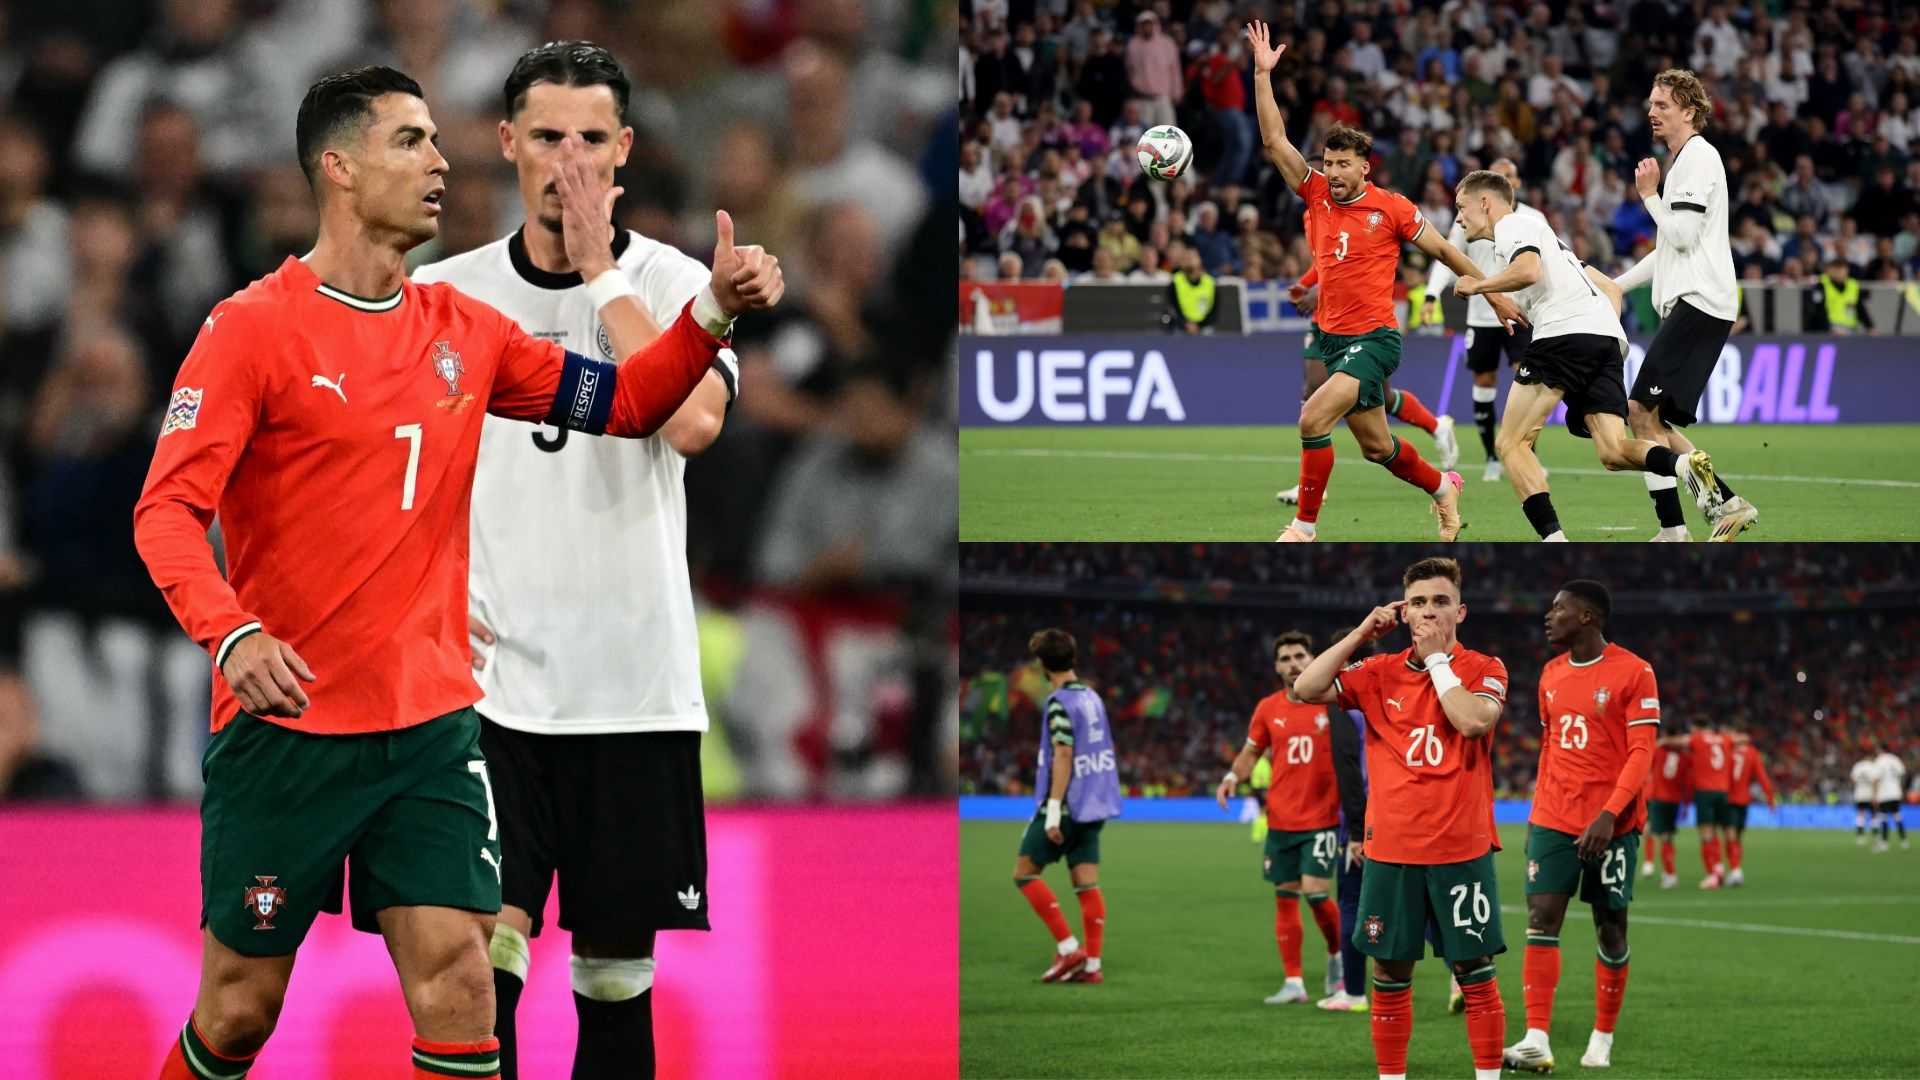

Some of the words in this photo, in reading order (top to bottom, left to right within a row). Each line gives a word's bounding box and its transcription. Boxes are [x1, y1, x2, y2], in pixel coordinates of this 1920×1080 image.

[1335, 231, 1350, 262] 3
[574, 368, 596, 419] RESPECT
[976, 350, 1187, 422] UEFA
[394, 423, 423, 511] 7
[1287, 735, 1314, 764] 20
[1405, 724, 1444, 767] 26
[1559, 714, 1589, 750] 25
[467, 760, 498, 841] 7
[1312, 831, 1337, 860] 20
[1601, 847, 1627, 885] 25
[1450, 881, 1491, 928] 26
